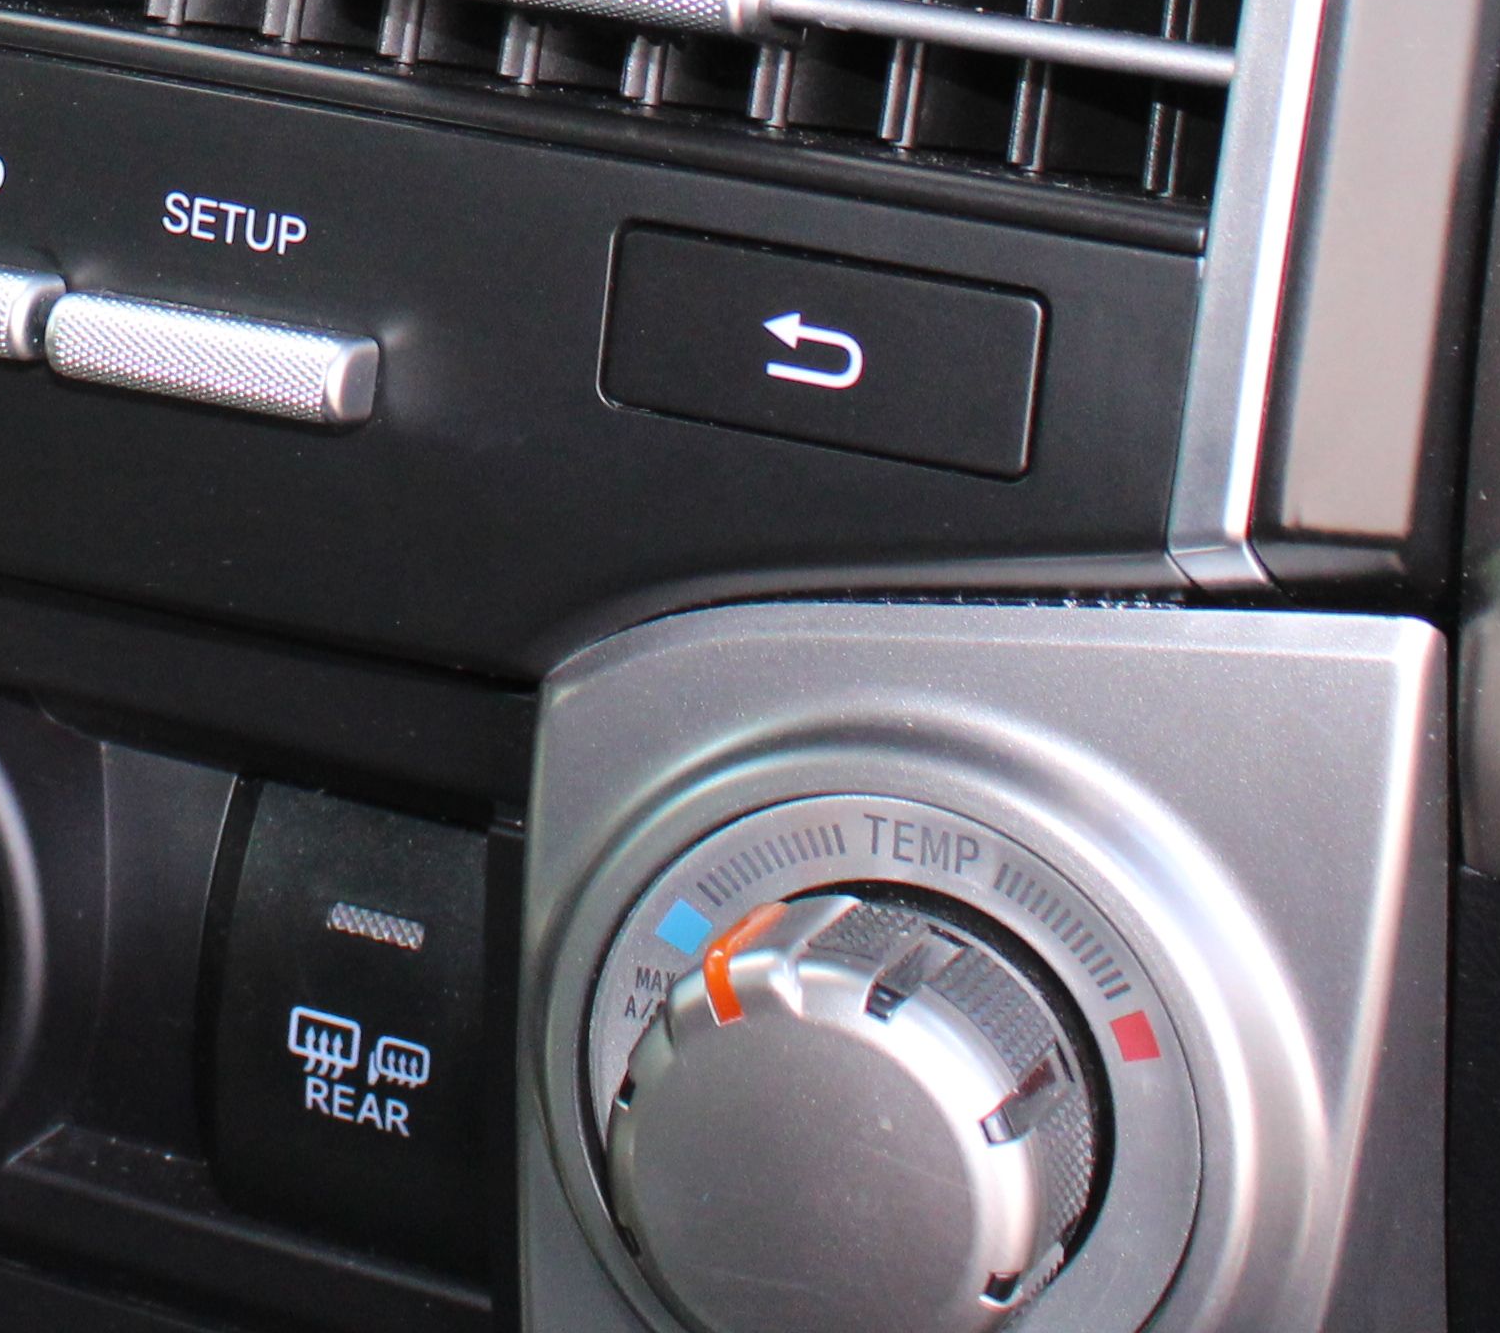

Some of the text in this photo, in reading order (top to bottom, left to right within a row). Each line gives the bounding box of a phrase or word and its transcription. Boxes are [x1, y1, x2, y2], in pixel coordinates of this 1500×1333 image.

[162, 191, 309, 256] SETUP
[861, 812, 983, 877] TEMP
[623, 994, 660, 1020] A/
[304, 1076, 411, 1137] REAR
